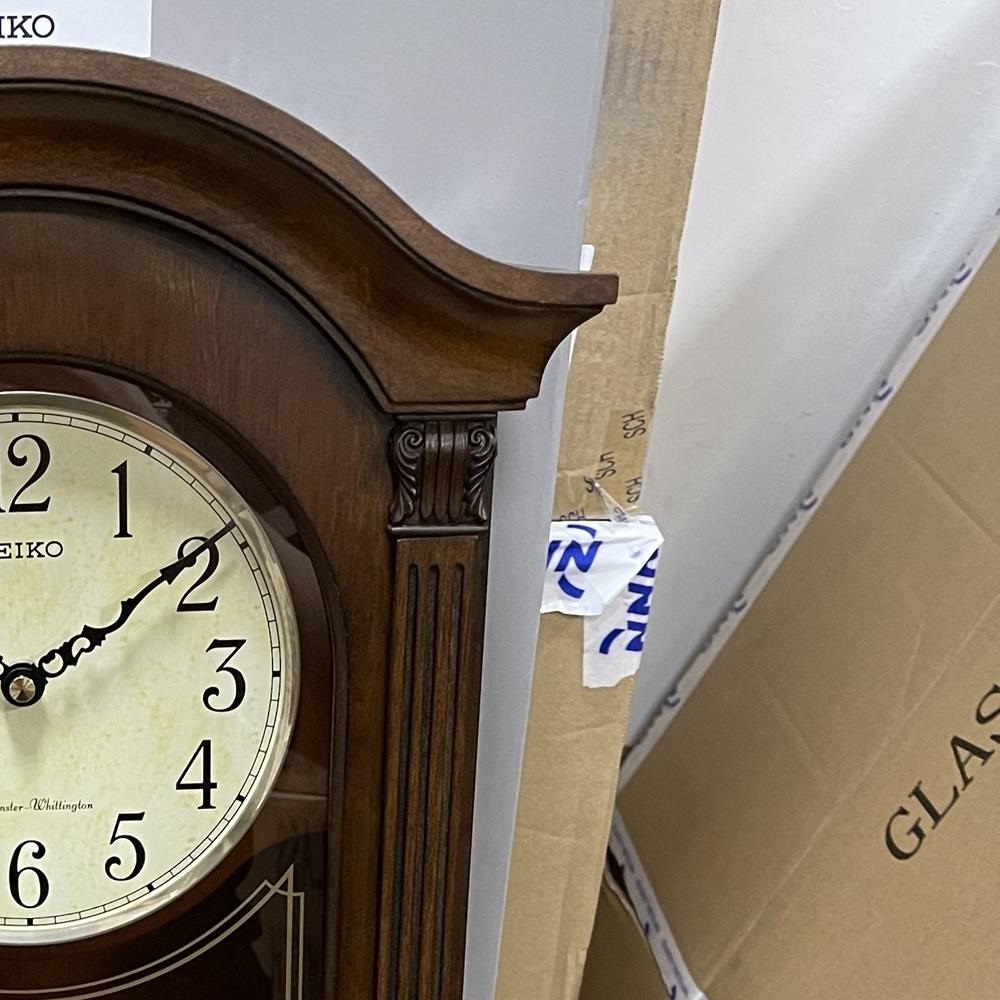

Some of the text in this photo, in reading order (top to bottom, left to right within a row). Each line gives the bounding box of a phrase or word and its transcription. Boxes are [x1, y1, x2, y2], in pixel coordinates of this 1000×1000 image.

[111, 460, 133, 538] 1
[176, 537, 219, 612] 2
[202, 639, 246, 712] 3
[175, 740, 217, 810] 4
[8, 840, 50, 908] 6
[105, 812, 145, 881] 5
